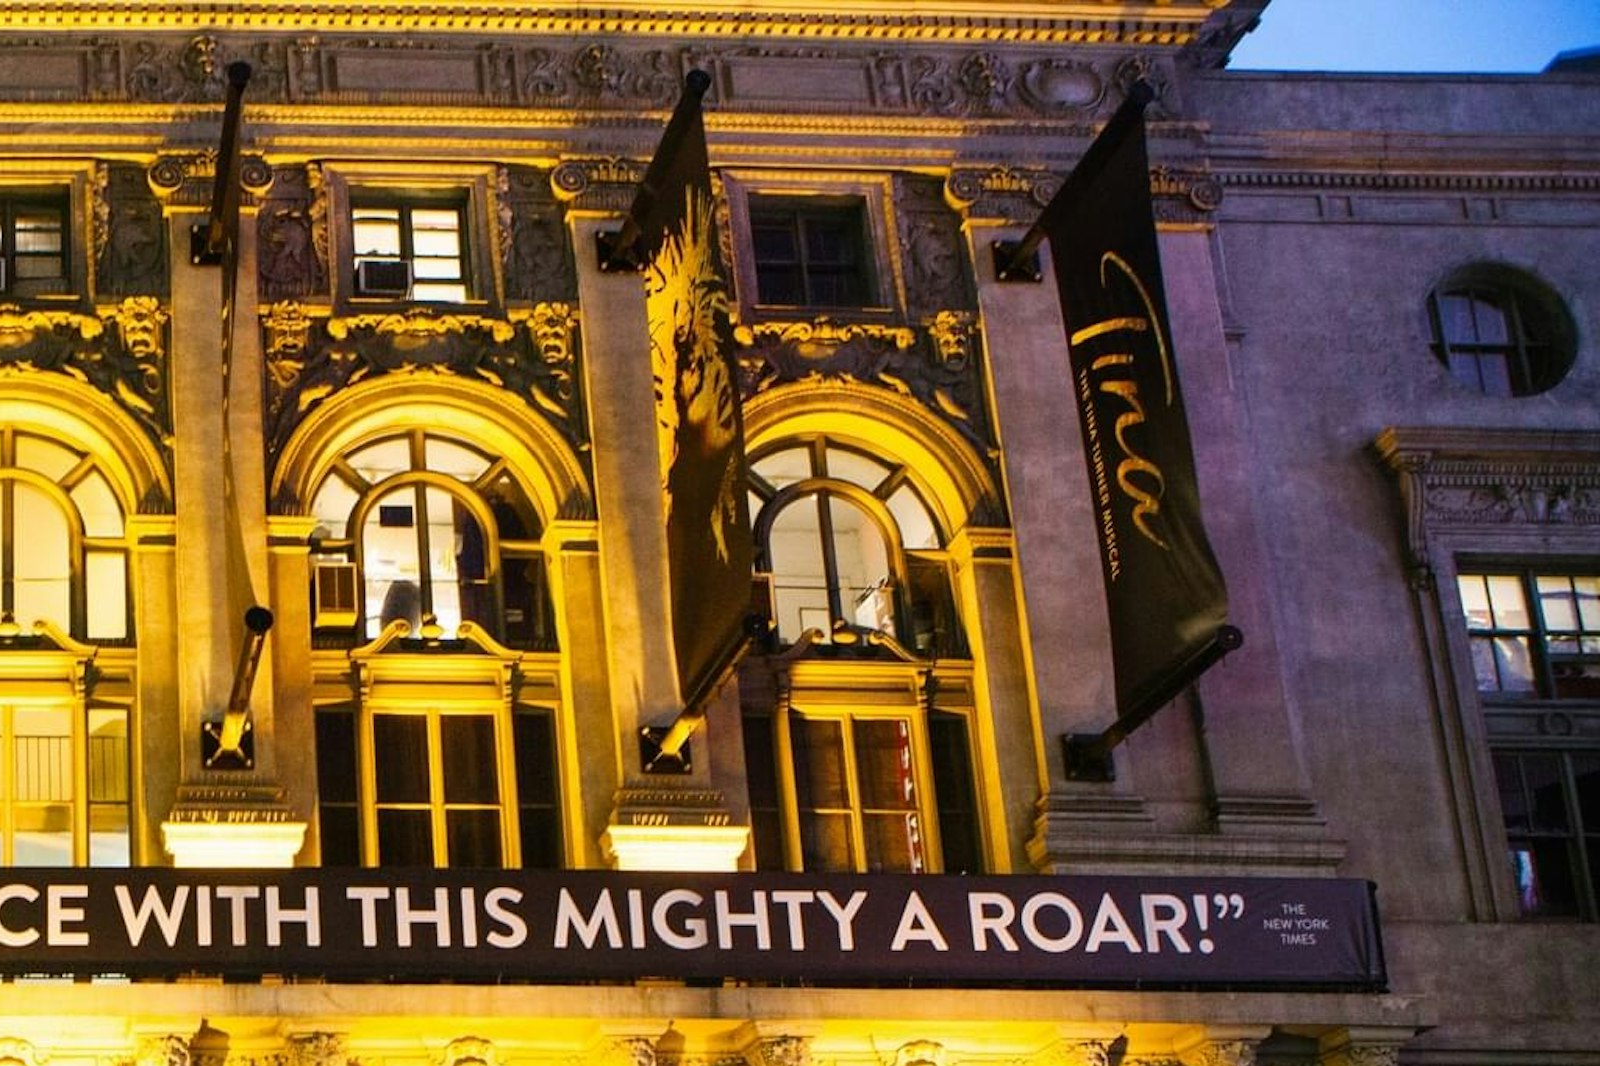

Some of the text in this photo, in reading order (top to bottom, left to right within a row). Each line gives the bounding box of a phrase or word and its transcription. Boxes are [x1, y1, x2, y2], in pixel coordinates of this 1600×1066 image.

[1071, 250, 1171, 550] Tina
[1084, 406, 1098, 440] TINA
[1092, 444, 1110, 504] TURNER
[1102, 509, 1121, 582] MUSICAL
[115, 885, 322, 948] WITH
[347, 886, 528, 949] THIS
[553, 887, 868, 952] MIGHTY
[891, 890, 948, 952] A
[967, 892, 1244, 955] ROAR!”
[1263, 918, 1330, 930] NEW YORK
[1281, 903, 1307, 916] THE
[1280, 933, 1317, 945] TIMES
